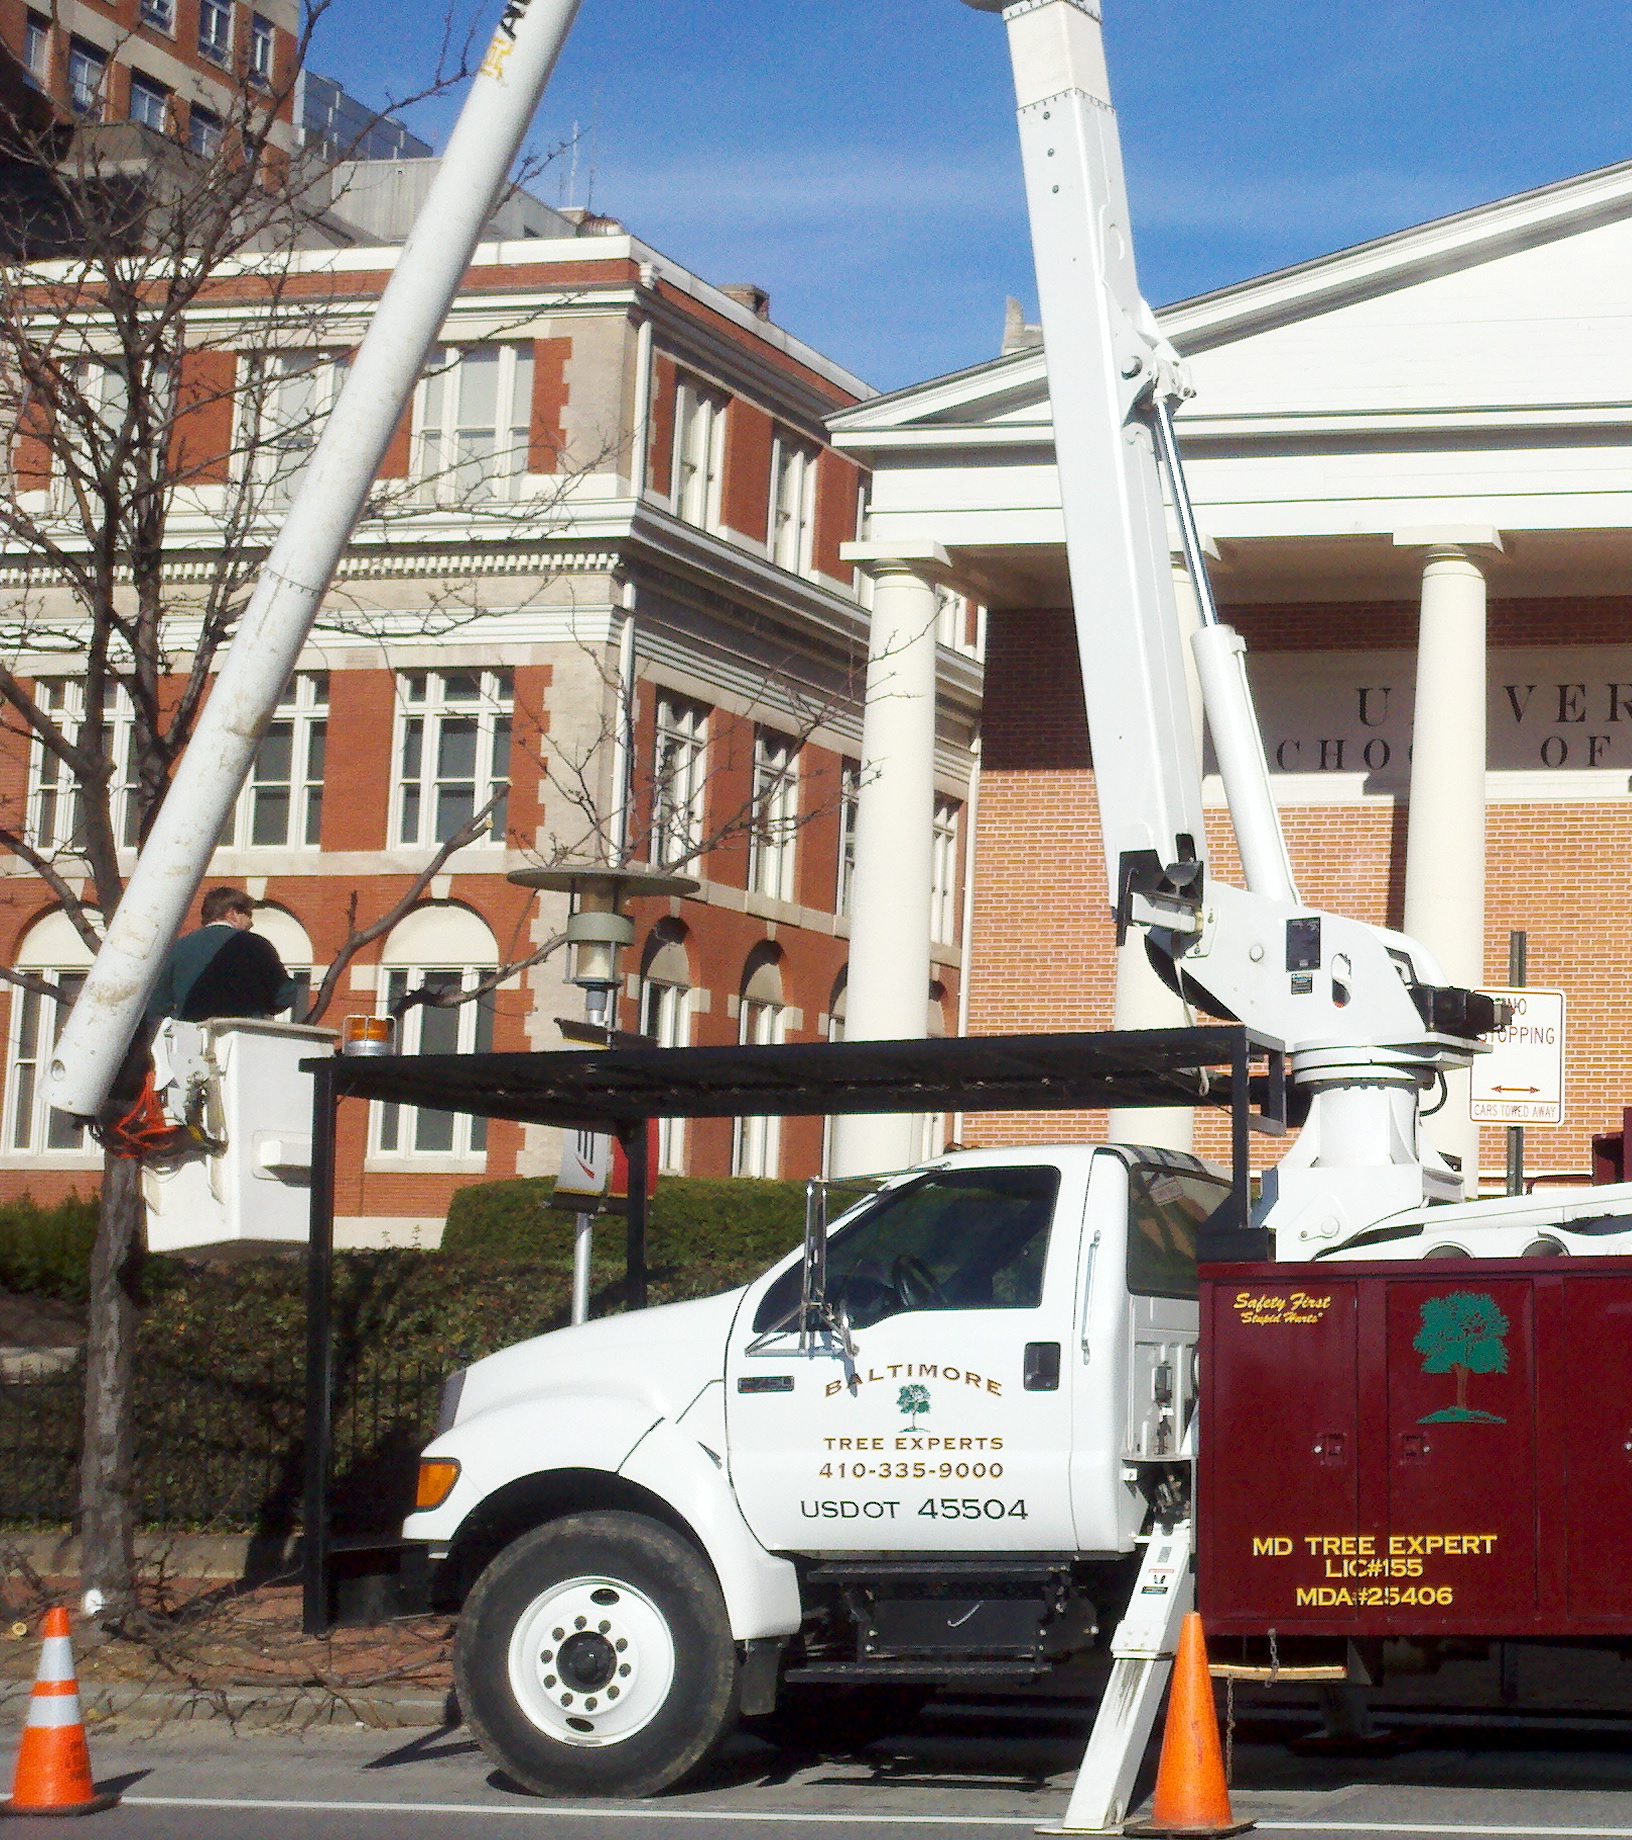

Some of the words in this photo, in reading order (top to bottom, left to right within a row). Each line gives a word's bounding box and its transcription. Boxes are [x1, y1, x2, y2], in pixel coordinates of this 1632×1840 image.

[1540, 735, 1611, 768] OF
[1474, 1104, 1498, 1116] CARS
[1501, 1105, 1529, 1118] TOWED
[1532, 1106, 1557, 1118] AWAY
[1233, 1292, 1286, 1312] Safety
[1290, 1291, 1332, 1311] First
[825, 1363, 1003, 1397] BALTIMORE
[823, 1437, 884, 1451] TREE
[895, 1436, 1004, 1451] EXPERTS
[819, 1462, 1004, 1479] 410-335-9000
[800, 1500, 901, 1519] USDOT
[917, 1498, 1029, 1520] 45504
[1252, 1537, 1293, 1556] MD
[1304, 1536, 1375, 1555] TREE
[1389, 1535, 1498, 1555] EXPERT
[1325, 1558, 1424, 1577] LIC#155
